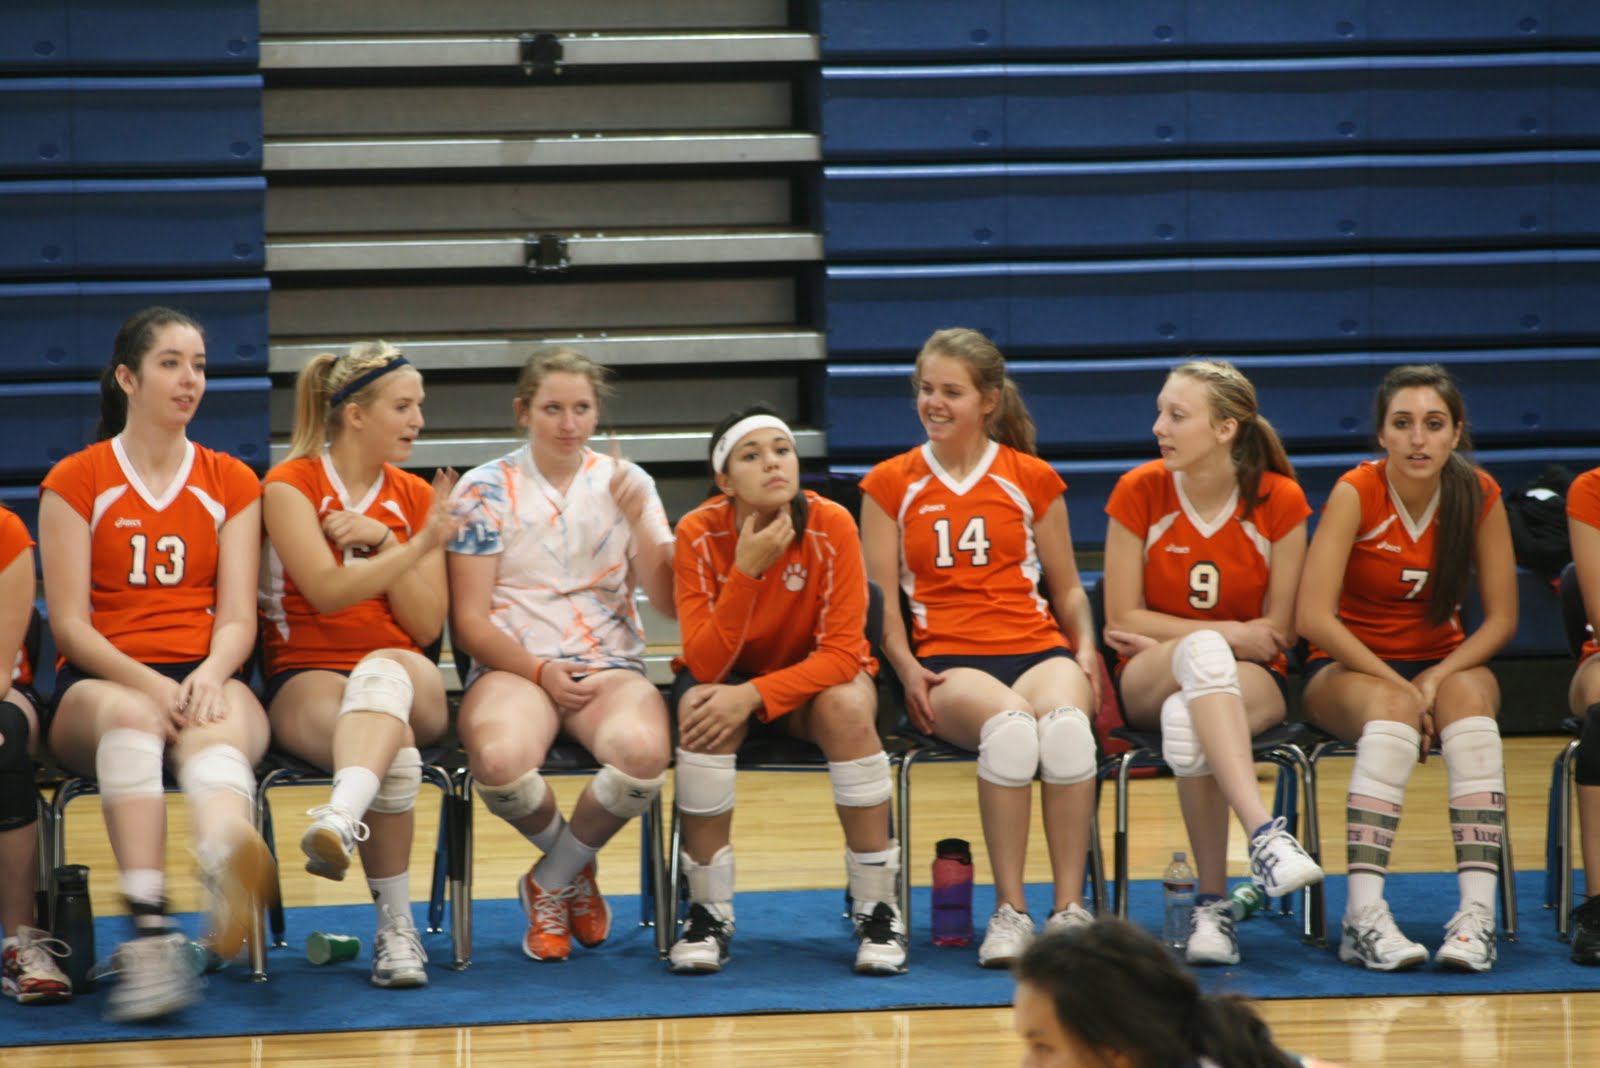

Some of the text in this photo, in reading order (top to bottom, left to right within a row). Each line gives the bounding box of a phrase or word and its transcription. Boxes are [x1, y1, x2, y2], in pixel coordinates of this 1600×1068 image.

[128, 533, 186, 586] 13
[933, 516, 991, 568] 14
[1188, 561, 1220, 610] 9
[1400, 568, 1430, 600] 7
